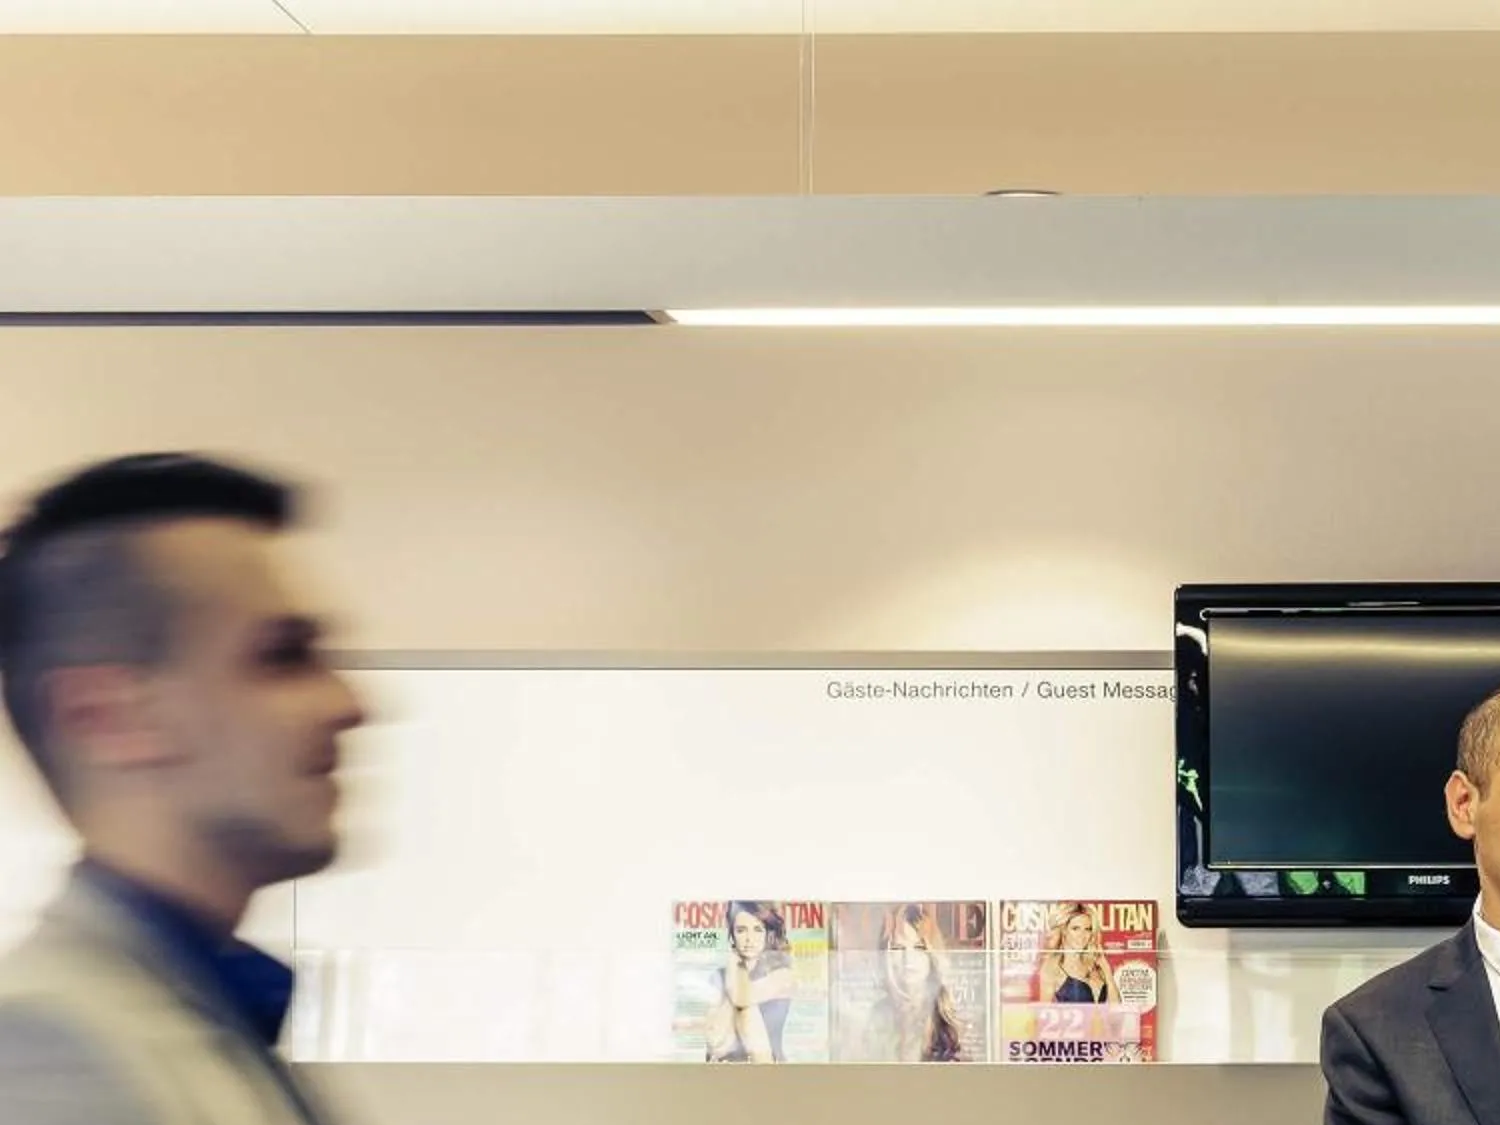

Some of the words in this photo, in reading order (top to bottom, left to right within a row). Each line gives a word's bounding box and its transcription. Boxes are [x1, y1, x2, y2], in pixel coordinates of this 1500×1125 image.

[826, 680, 1013, 700] Gäste-Nachrichten
[1021, 681, 1030, 699] /
[1036, 681, 1096, 700] Guest
[1103, 681, 1177, 703] Messag
[1408, 875, 1450, 885] PHILIPS
[674, 901, 824, 929] COSMITAN
[1001, 903, 1153, 933] COSMLITAN
